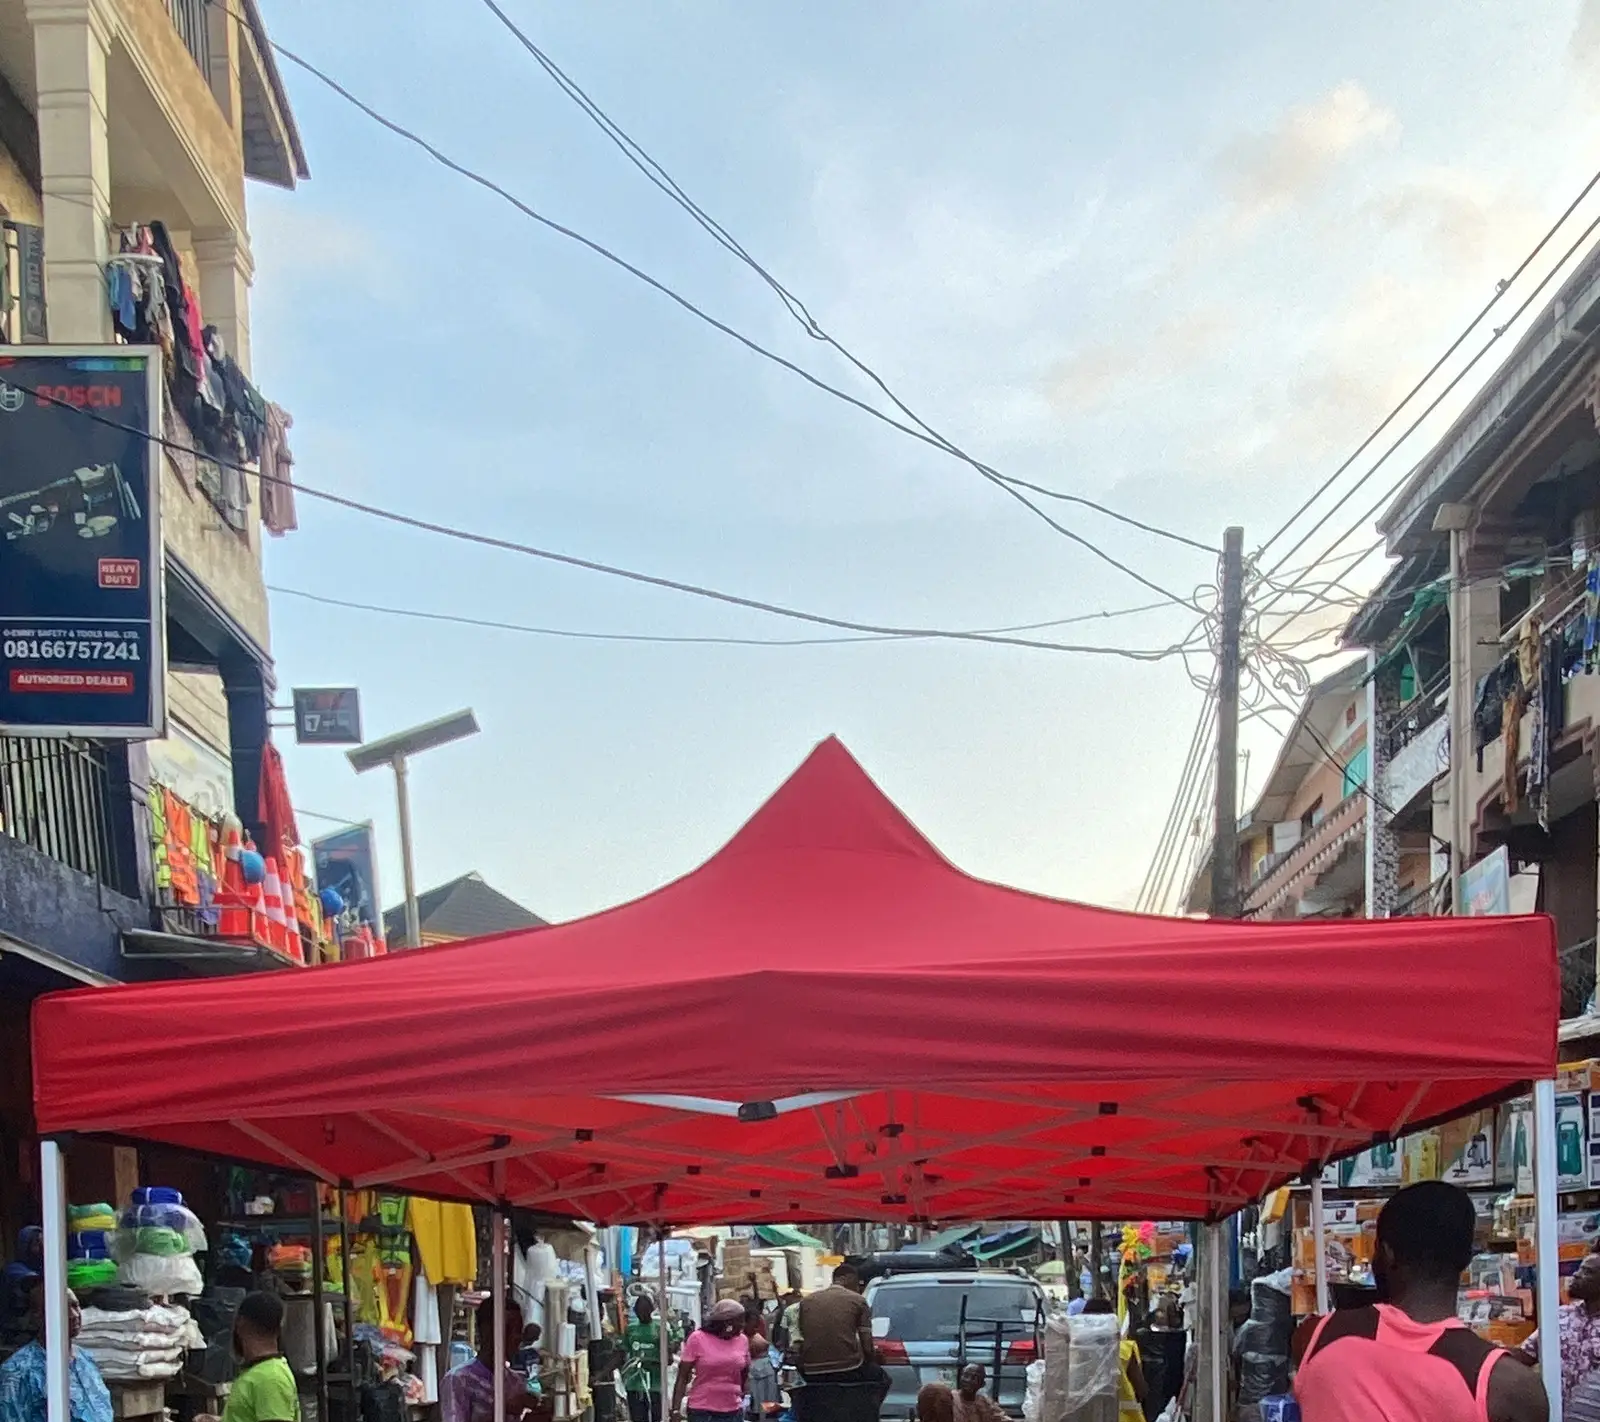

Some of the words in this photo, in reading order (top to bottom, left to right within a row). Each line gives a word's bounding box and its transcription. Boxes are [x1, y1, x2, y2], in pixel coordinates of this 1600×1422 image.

[35, 384, 122, 408] BOSCH
[101, 564, 136, 573] HEAVY
[104, 575, 132, 584] DUTY
[3, 639, 140, 660] 08166757241
[18, 675, 85, 685] AUTHORIZED
[86, 676, 128, 686] DEALER
